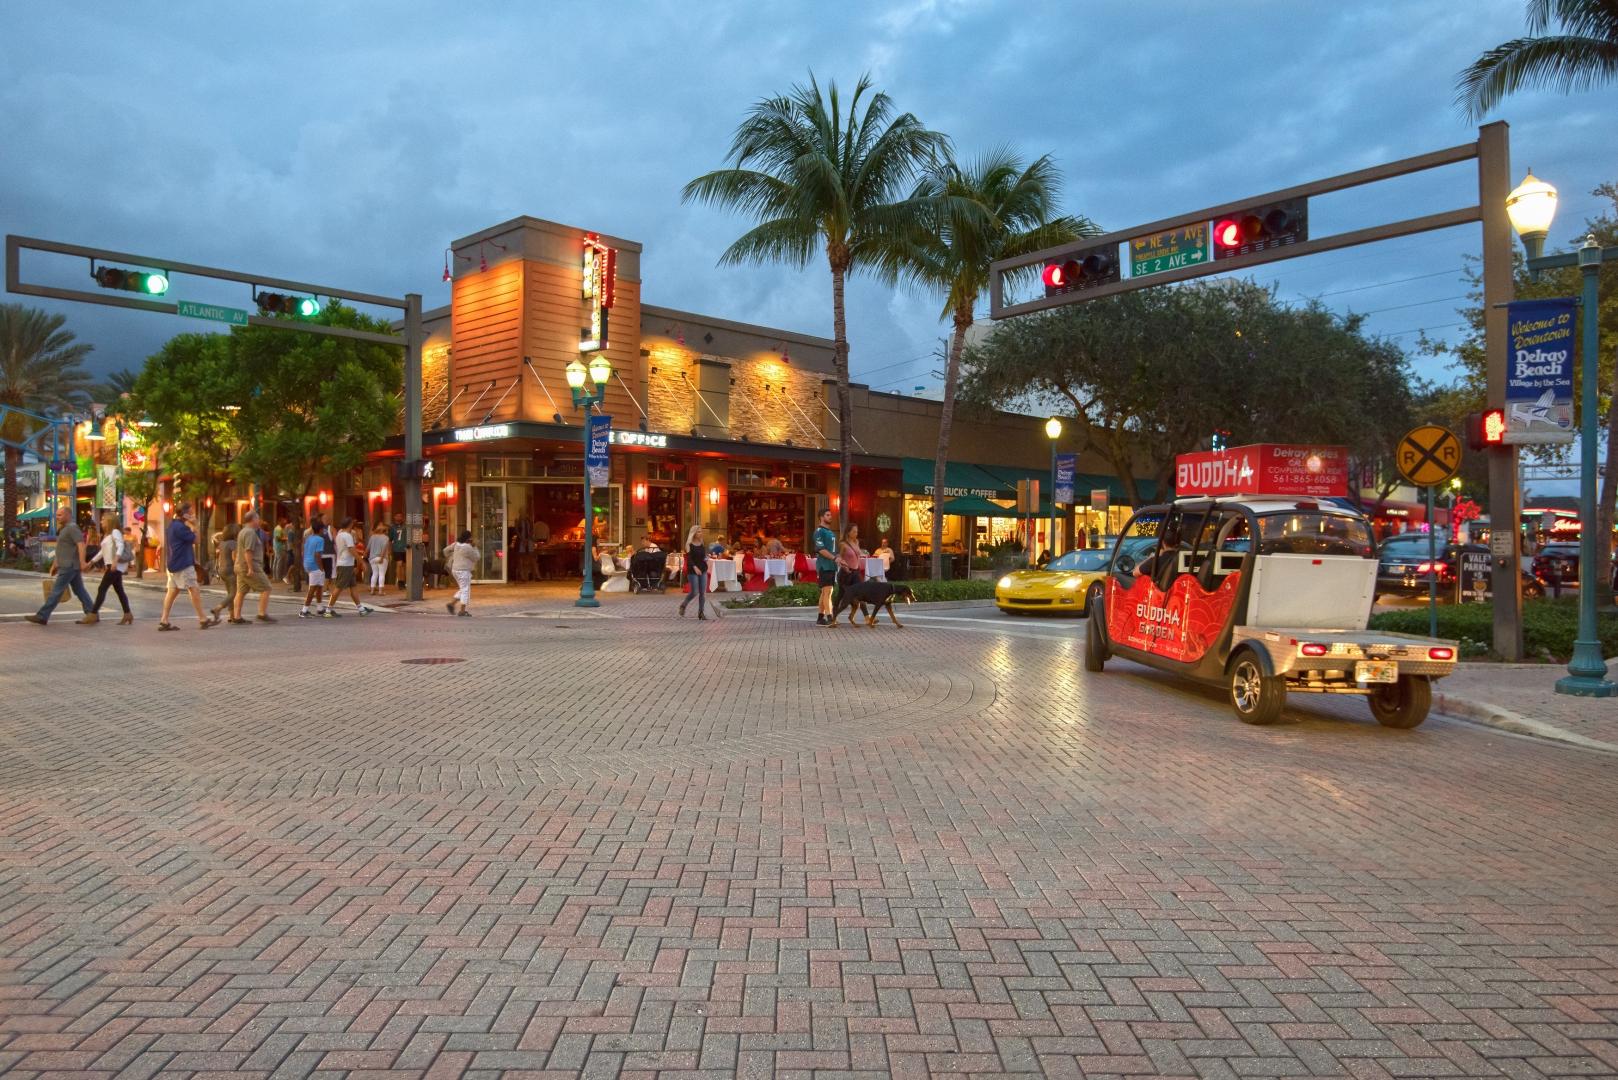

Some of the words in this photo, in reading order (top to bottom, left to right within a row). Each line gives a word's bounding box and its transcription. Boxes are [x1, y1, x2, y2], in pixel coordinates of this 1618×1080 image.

[1150, 235, 1162, 248] NE
[1170, 232, 1176, 244] 2
[1185, 225, 1203, 240] AVE
[1136, 262, 1148, 275] SE
[1154, 260, 1161, 271] 2
[1169, 253, 1187, 268] AVE
[182, 304, 224, 319] ATLANTIC
[233, 312, 244, 322] AV
[1512, 319, 1555, 336] Welcome
[1557, 314, 1570, 325] to
[1514, 328, 1571, 350] Downtown
[1515, 350, 1567, 364] Delray
[1515, 362, 1562, 378] Beach
[1509, 379, 1533, 388] Village
[1534, 380, 1542, 389] by
[1543, 379, 1554, 387] the
[1555, 378, 1570, 386] Sea
[620, 432, 667, 447] OFFICE
[1273, 447, 1308, 459] Delray
[1404, 451, 1415, 464] R
[1444, 446, 1456, 459] R
[1178, 455, 1253, 488] BUDDHA
[924, 486, 968, 496] STBUCKS
[971, 488, 997, 498] COFFEE
[1468, 554, 1491, 563] VALE
[1463, 563, 1492, 572] PARKIN
[1136, 603, 1180, 626] BUDDHA
